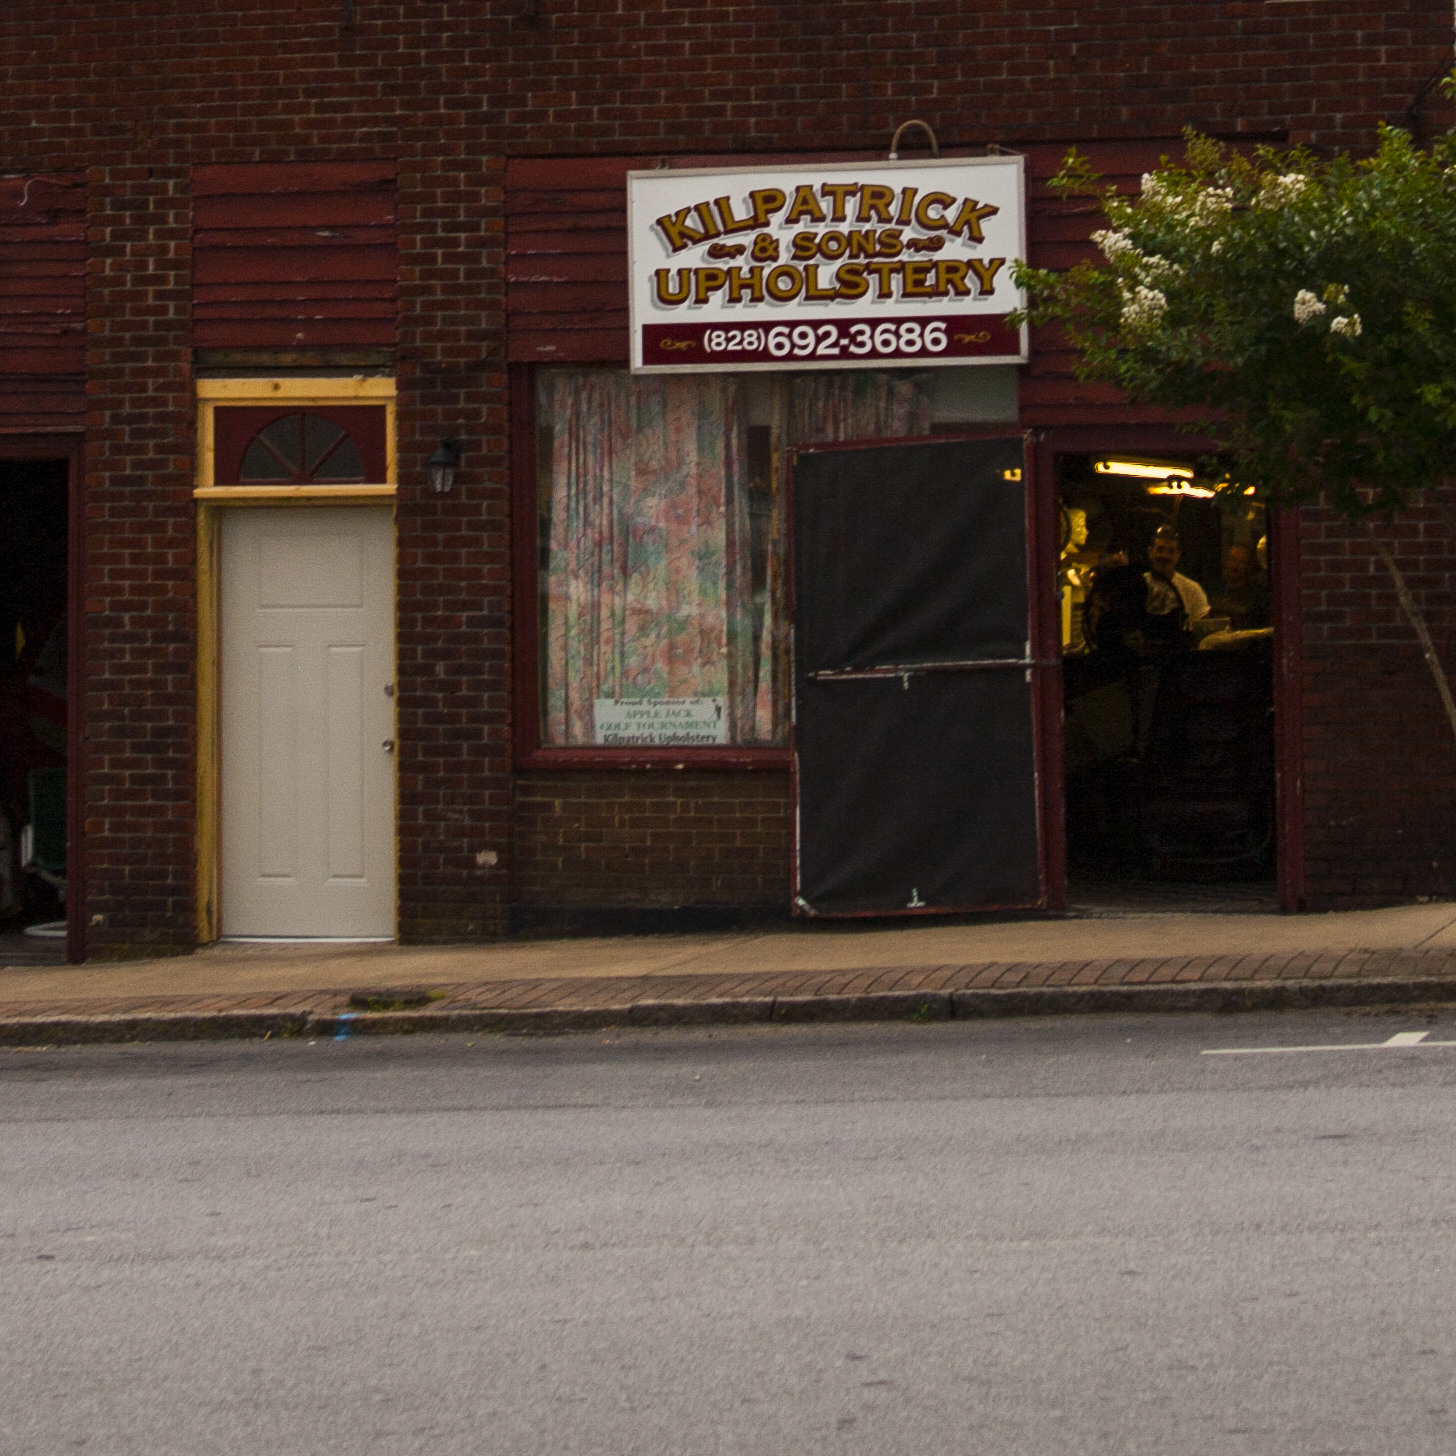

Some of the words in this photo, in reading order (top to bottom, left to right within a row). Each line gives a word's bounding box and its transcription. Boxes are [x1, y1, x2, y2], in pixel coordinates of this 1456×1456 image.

[656, 182, 1000, 252] KILPATRICK
[751, 233, 781, 263] &
[791, 229, 904, 261] SONS
[655, 258, 1006, 304] UPHOLSTERY
[603, 733, 656, 745] Kilpatrick
[658, 732, 718, 745] Upholstery
